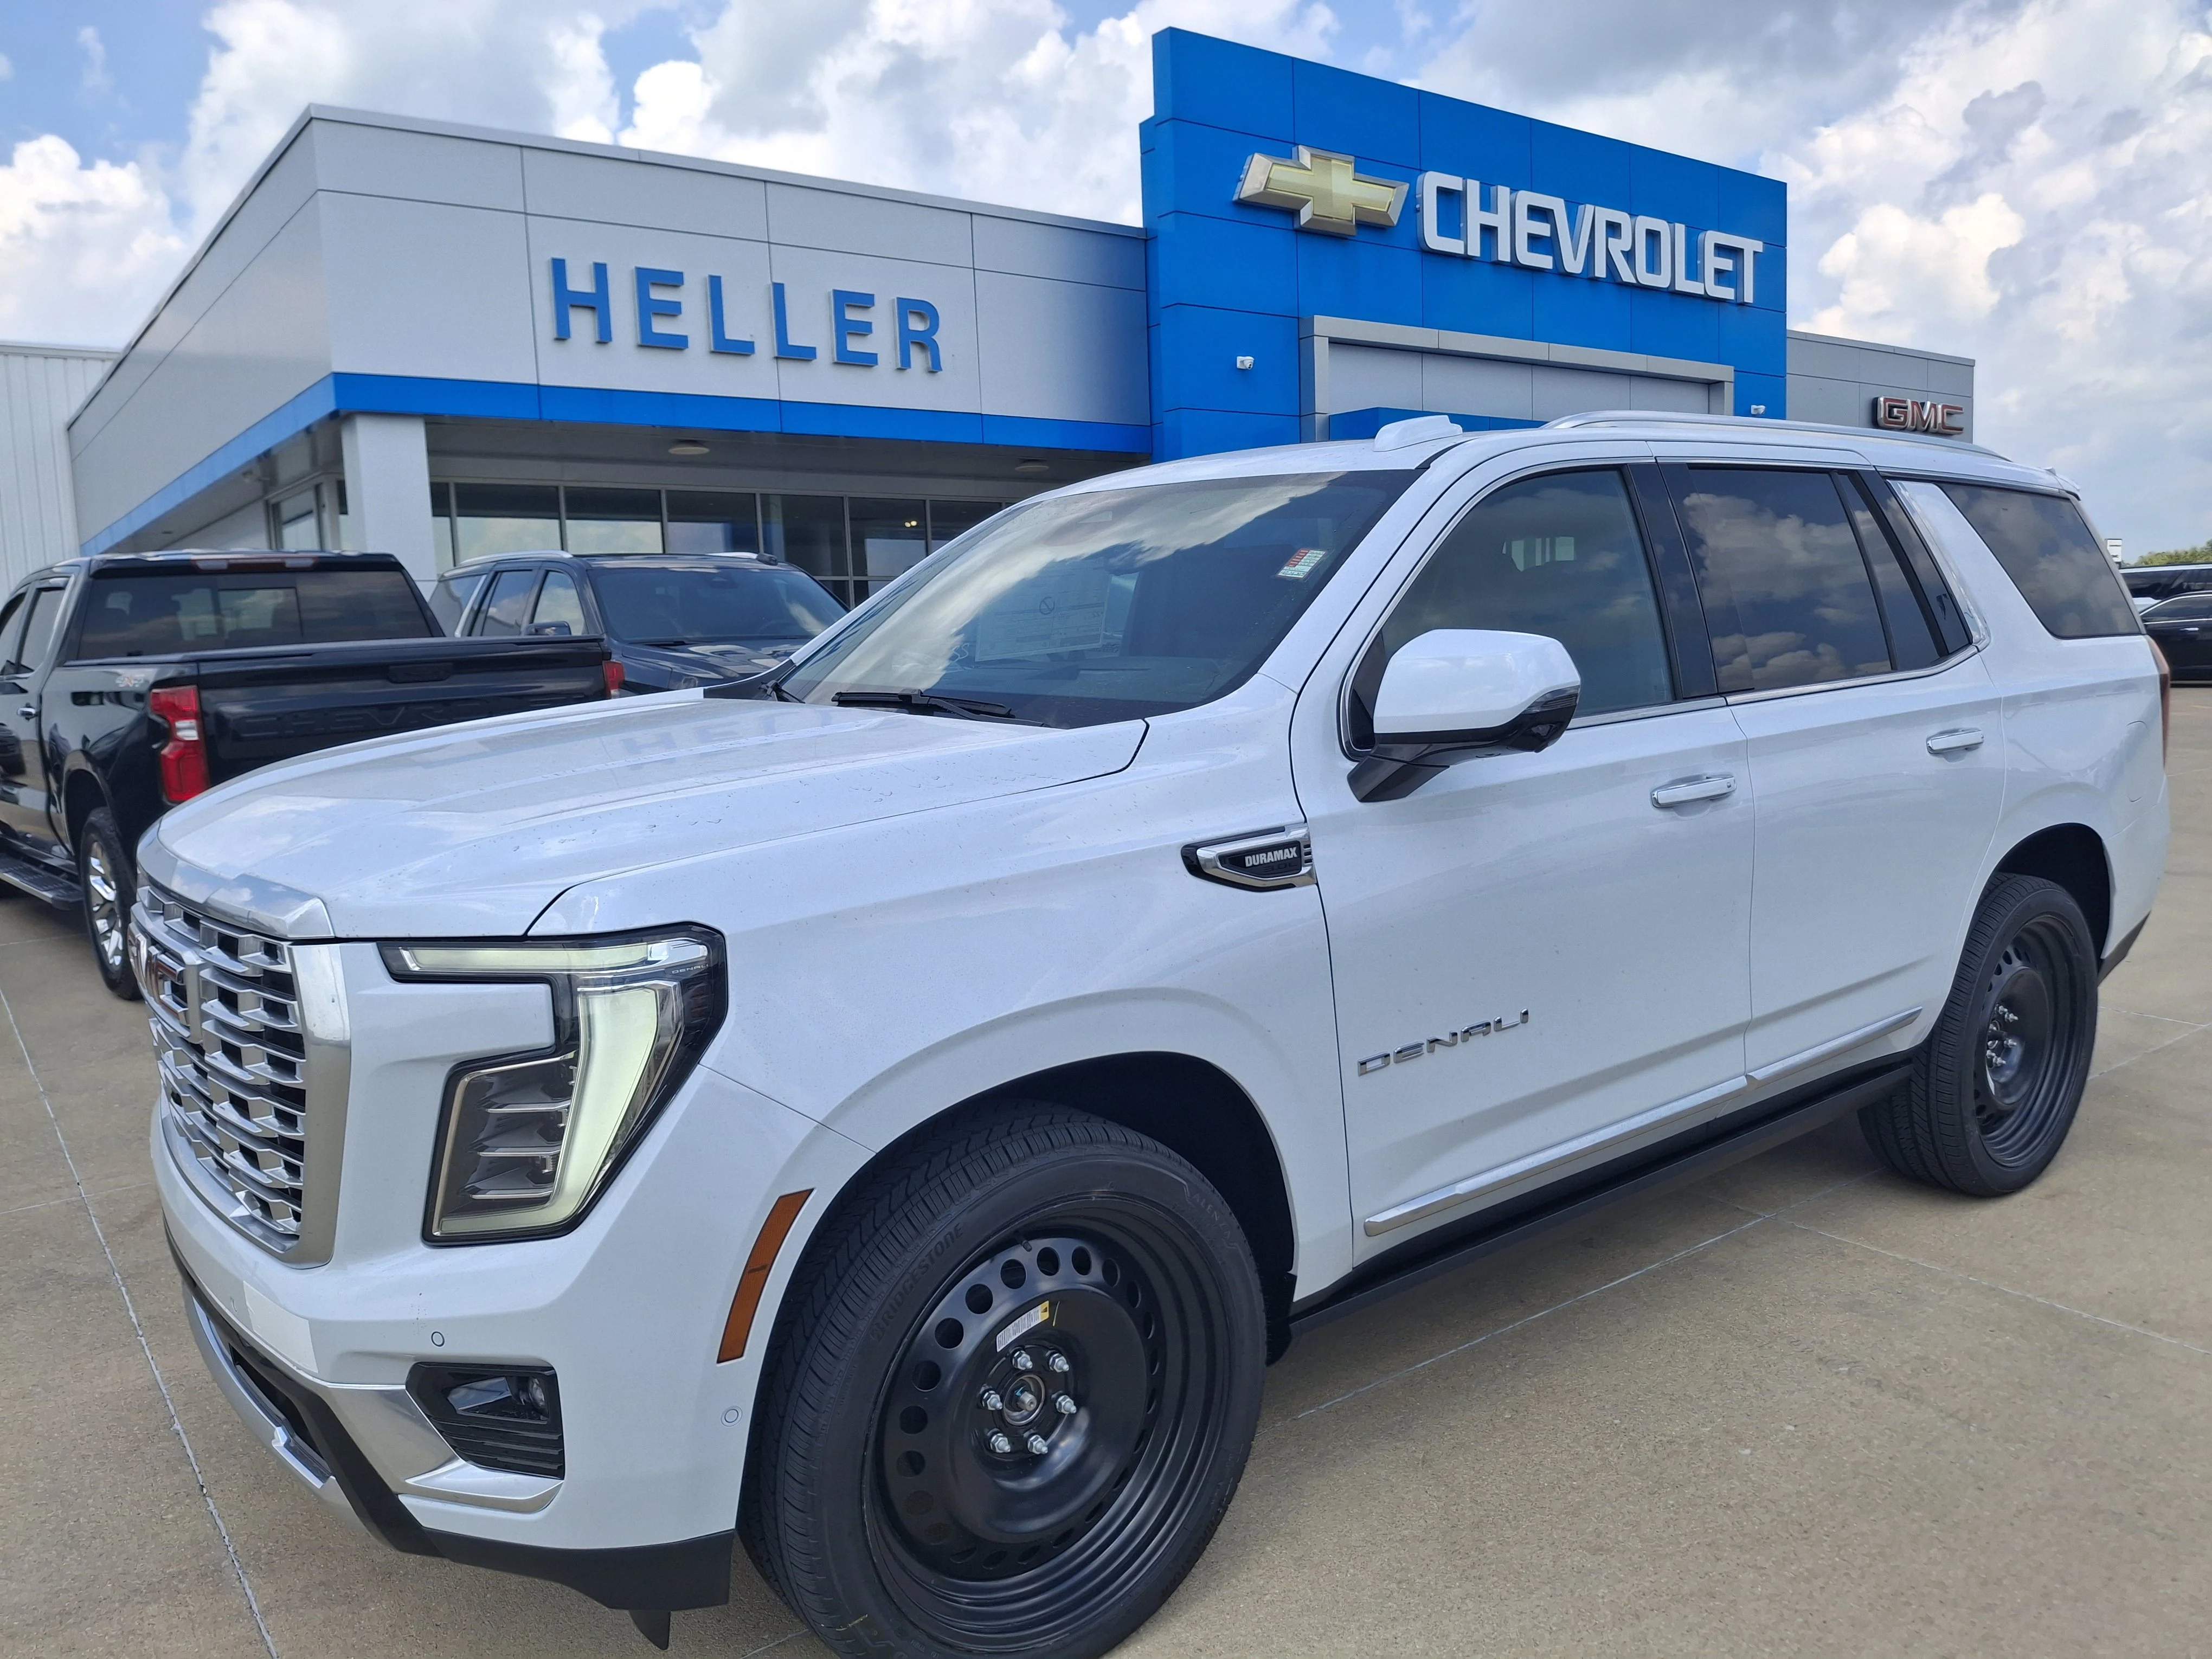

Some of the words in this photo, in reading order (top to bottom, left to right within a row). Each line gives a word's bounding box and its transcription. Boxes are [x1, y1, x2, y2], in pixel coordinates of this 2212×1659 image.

[1416, 170, 1763, 304] CHEVROLET
[550, 257, 943, 373] HELLER
[1873, 395, 1965, 435] GMC
[1245, 847, 1298, 867] DURAMAX
[672, 964, 709, 974] DENALI
[1358, 1008, 1529, 1077] DENALI
